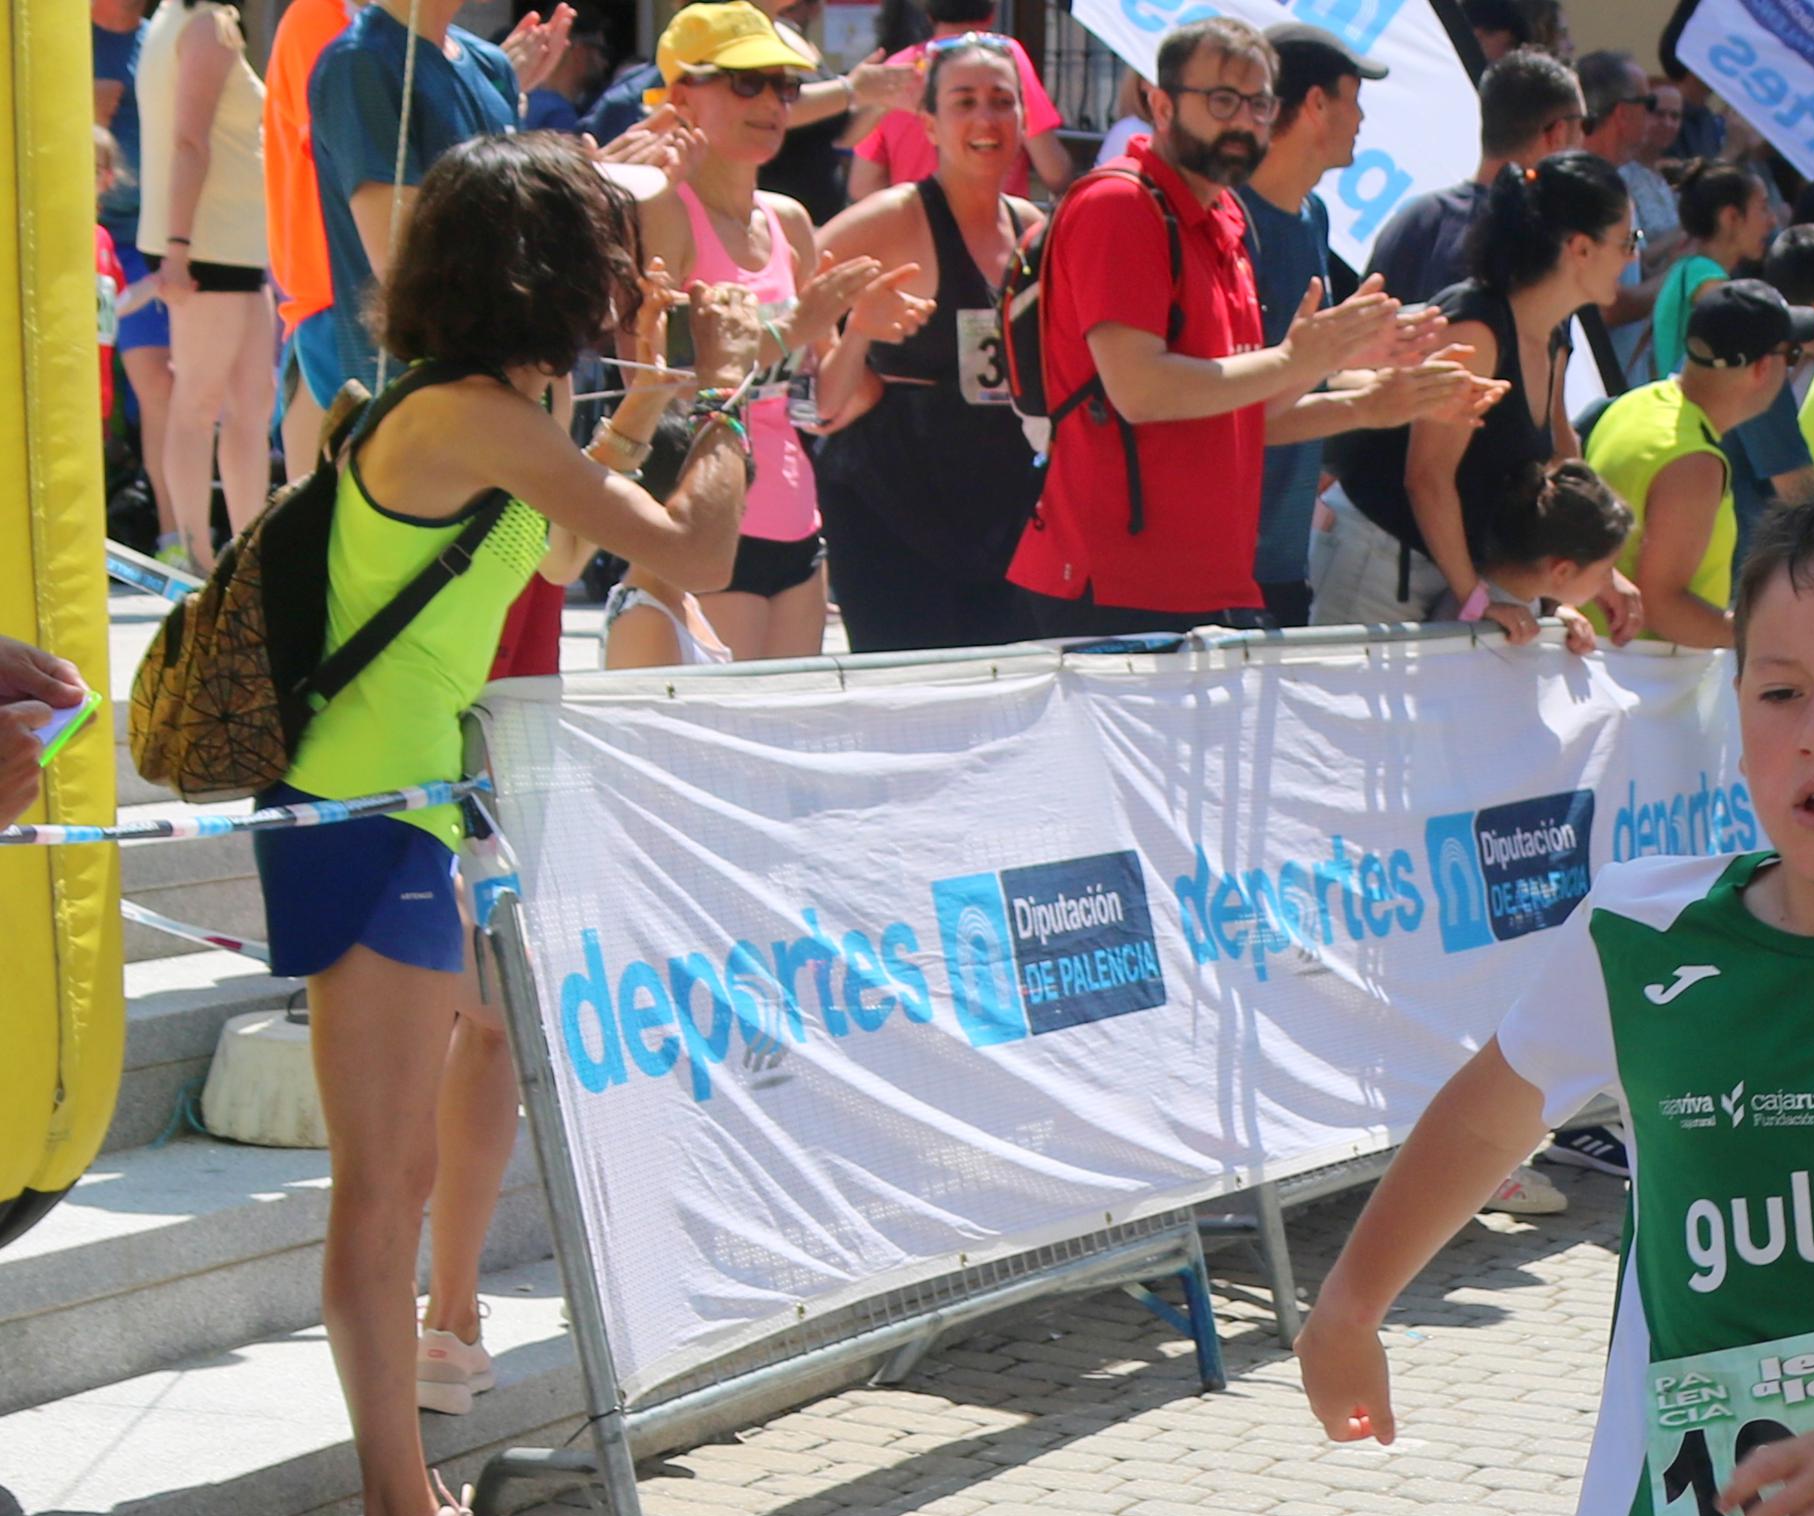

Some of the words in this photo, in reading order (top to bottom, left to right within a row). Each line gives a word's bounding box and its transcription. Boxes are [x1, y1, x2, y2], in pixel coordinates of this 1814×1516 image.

[1480, 818, 1577, 869] Diputación
[1013, 883, 1124, 945] Diputación
[1174, 834, 1424, 982] deportes
[1491, 882, 1518, 918] DE
[1024, 960, 1058, 1004] DE
[1058, 940, 1160, 997] PALENCIA
[560, 907, 933, 1100] deportes
[1655, 1371, 1713, 1395] PA
[1658, 1385, 1728, 1411] LEN
[1752, 1379, 1783, 1399] a
[1659, 1402, 1734, 1427] CIA
